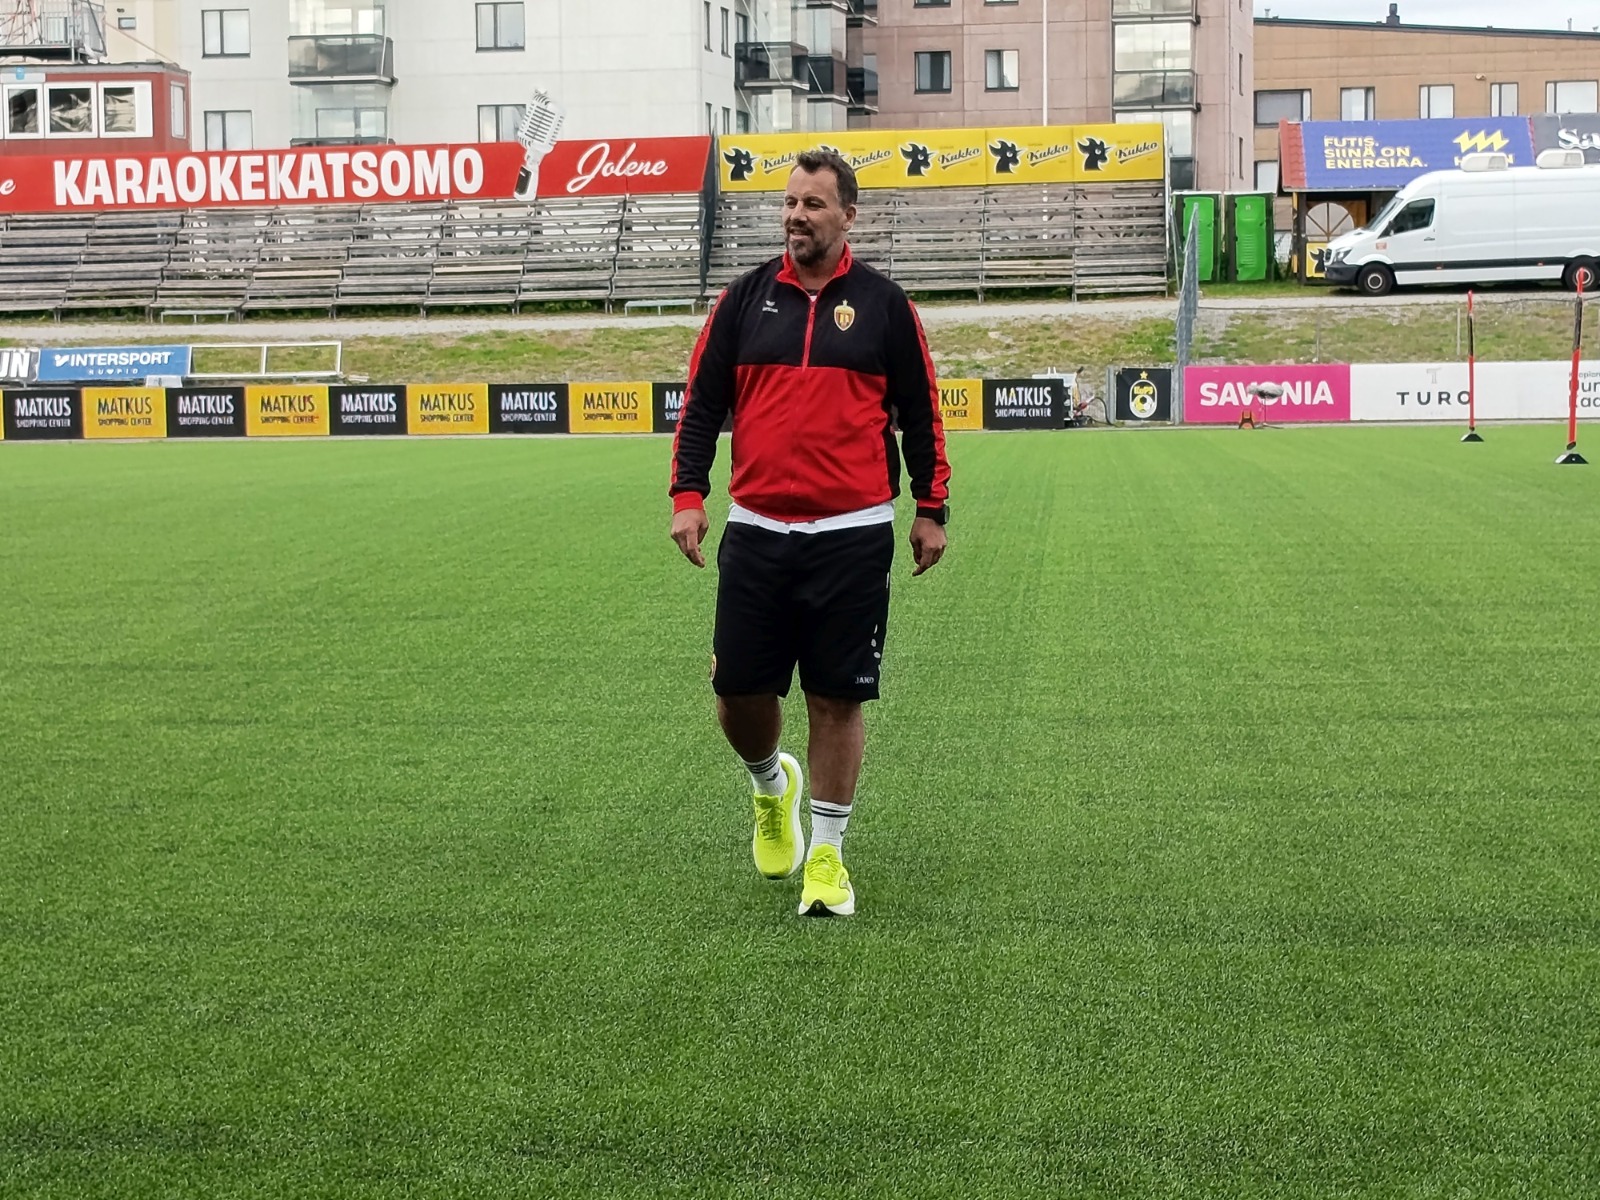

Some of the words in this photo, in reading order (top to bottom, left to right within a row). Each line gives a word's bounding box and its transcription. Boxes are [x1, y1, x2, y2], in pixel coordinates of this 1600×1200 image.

[1115, 141, 1158, 159] Kukko
[1323, 136, 1379, 147] FUTIS.
[761, 152, 799, 169] Kukk
[849, 150, 891, 166] Kukko
[938, 147, 980, 164] Kukko
[1026, 144, 1069, 162] Kukko
[1380, 146, 1411, 157] ON
[566, 142, 669, 193] Jolene
[1325, 157, 1428, 169] ENERGIAA.
[53, 148, 484, 206] KARAOKEKATSOMO
[70, 351, 171, 367] INTERSPORT
[178, 395, 235, 415] MATKUS
[260, 394, 315, 413] MATKUS
[340, 393, 397, 413] MATKUS
[420, 393, 475, 412] MATKUS
[501, 391, 557, 411] MATKUS
[583, 391, 638, 410] MATKUS
[995, 387, 1052, 406] MATKUS
[1396, 390, 1470, 405] TURO
[15, 397, 72, 417] MATKUS
[97, 397, 152, 415] MATKUS
